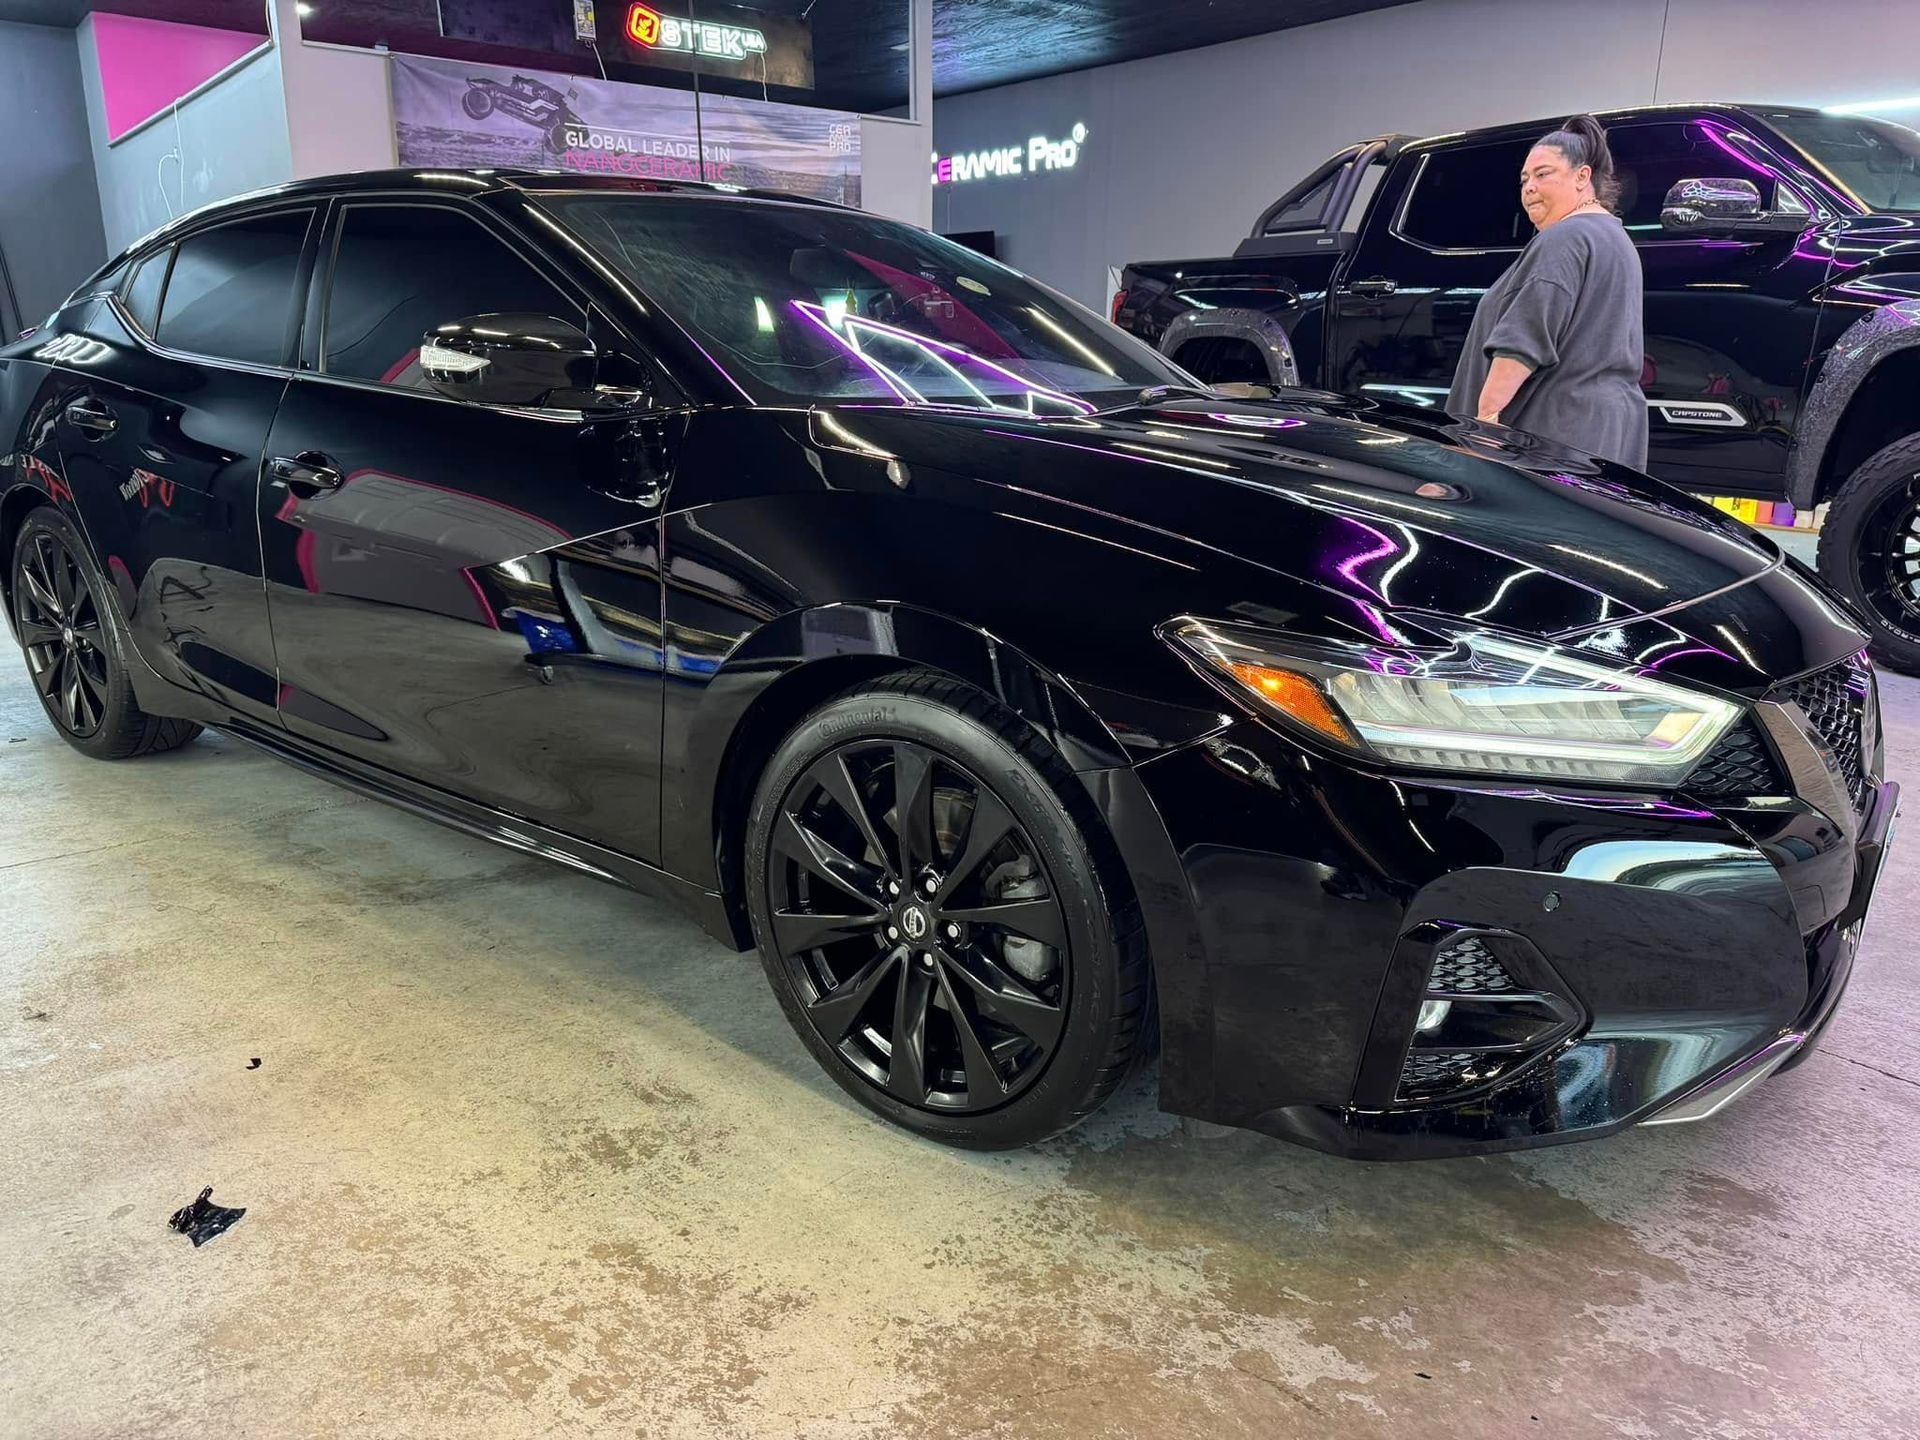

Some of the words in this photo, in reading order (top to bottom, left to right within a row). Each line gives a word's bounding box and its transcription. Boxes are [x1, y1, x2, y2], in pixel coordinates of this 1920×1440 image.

[660, 19, 744, 57] STEK
[565, 131, 638, 153] GLOBAL
[643, 139, 710, 160] LEADER
[714, 146, 731, 162] IN
[564, 150, 731, 180] NANOCERAMIC
[1671, 410, 1723, 418] CAPSTONE
